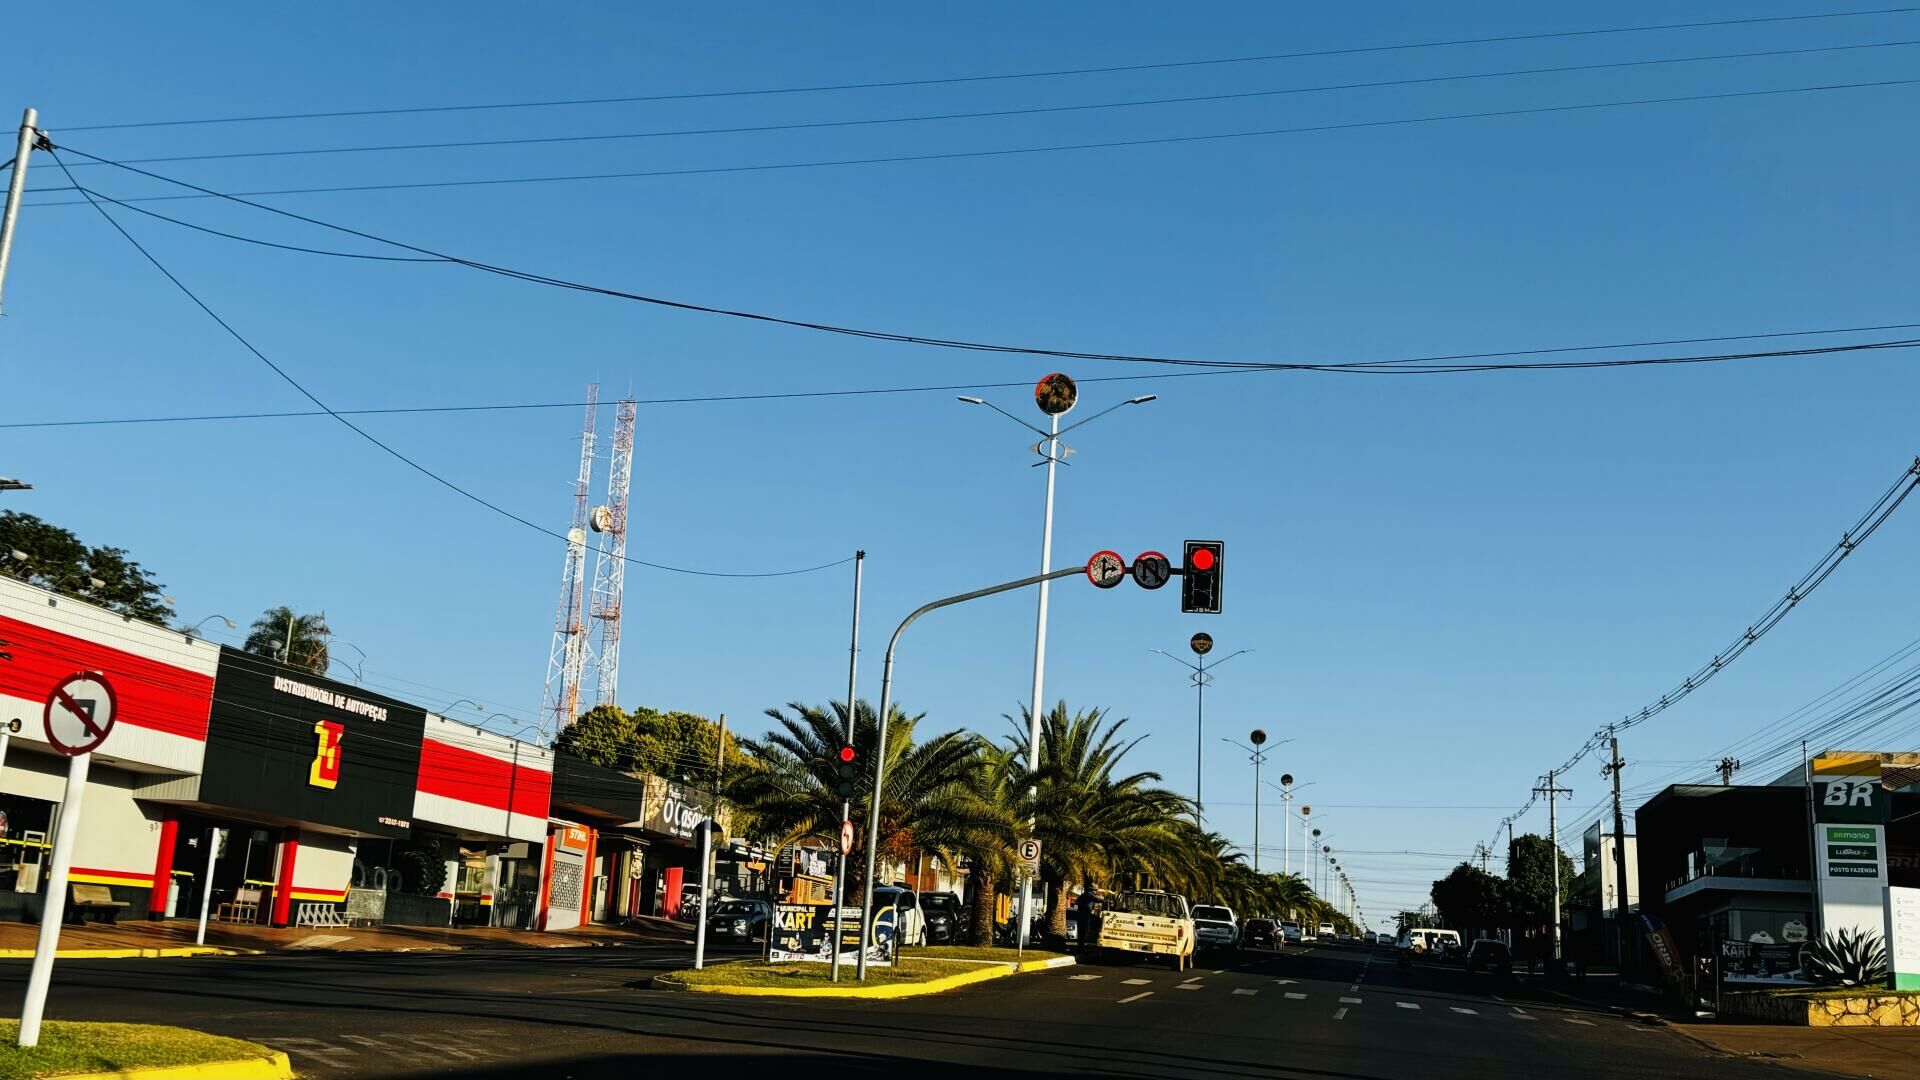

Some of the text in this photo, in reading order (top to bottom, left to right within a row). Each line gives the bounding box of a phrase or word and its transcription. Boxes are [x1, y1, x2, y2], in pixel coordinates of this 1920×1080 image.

[274, 676, 387, 722] DISTRIBUIDORA DE AUTOPEÇAS
[1823, 781, 1873, 807] BR
[569, 829, 587, 842] STIHL
[1025, 844, 1034, 857] E
[775, 912, 816, 929] KART
[1722, 944, 1752, 958] KART
